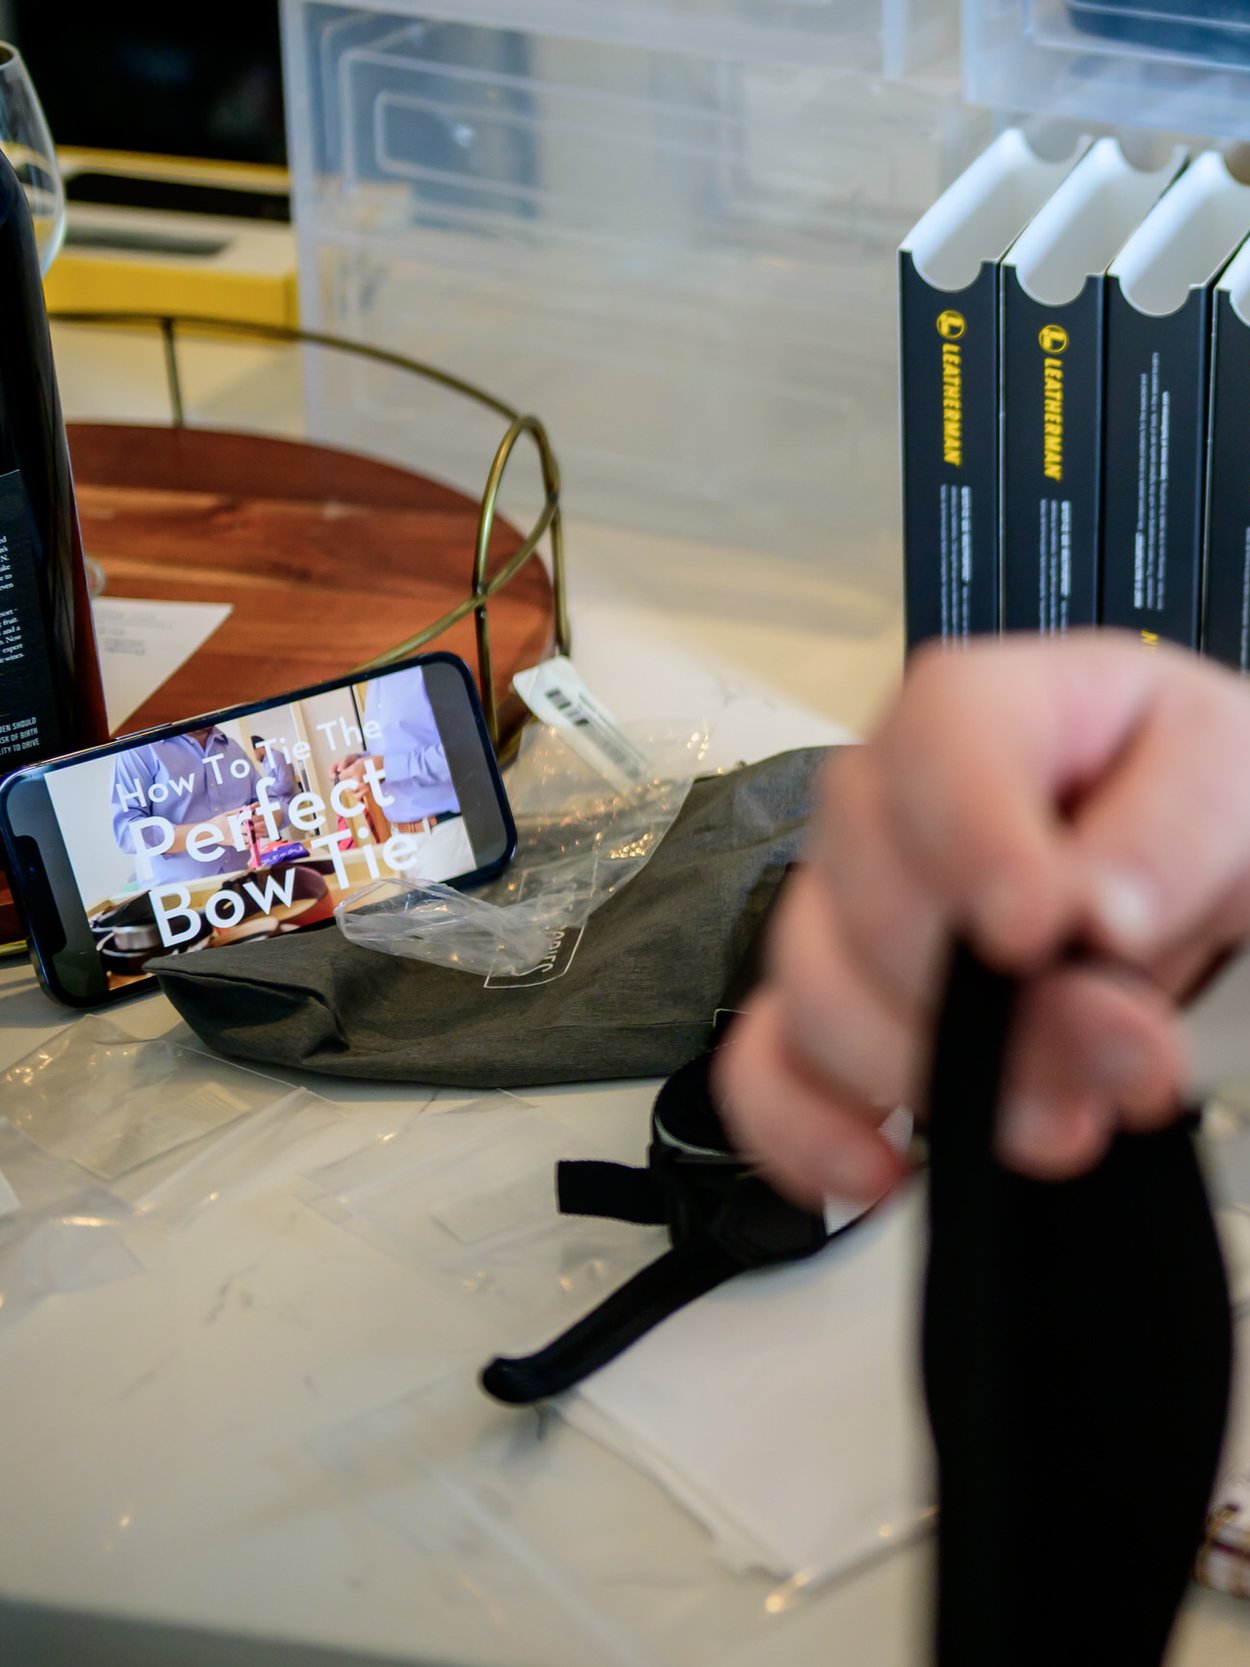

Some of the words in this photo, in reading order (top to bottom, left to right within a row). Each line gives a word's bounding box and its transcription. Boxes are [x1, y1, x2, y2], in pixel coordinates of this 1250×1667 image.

[942, 342, 962, 467] LEATHERMAN
[1043, 357, 1063, 482] LEATHERMAN
[115, 773, 196, 813] How
[202, 753, 251, 786] To
[255, 736, 312, 770] Tie
[316, 716, 383, 751] The
[129, 758, 395, 863] Perfect
[148, 867, 297, 948] Bow
[310, 826, 419, 891] Tie
